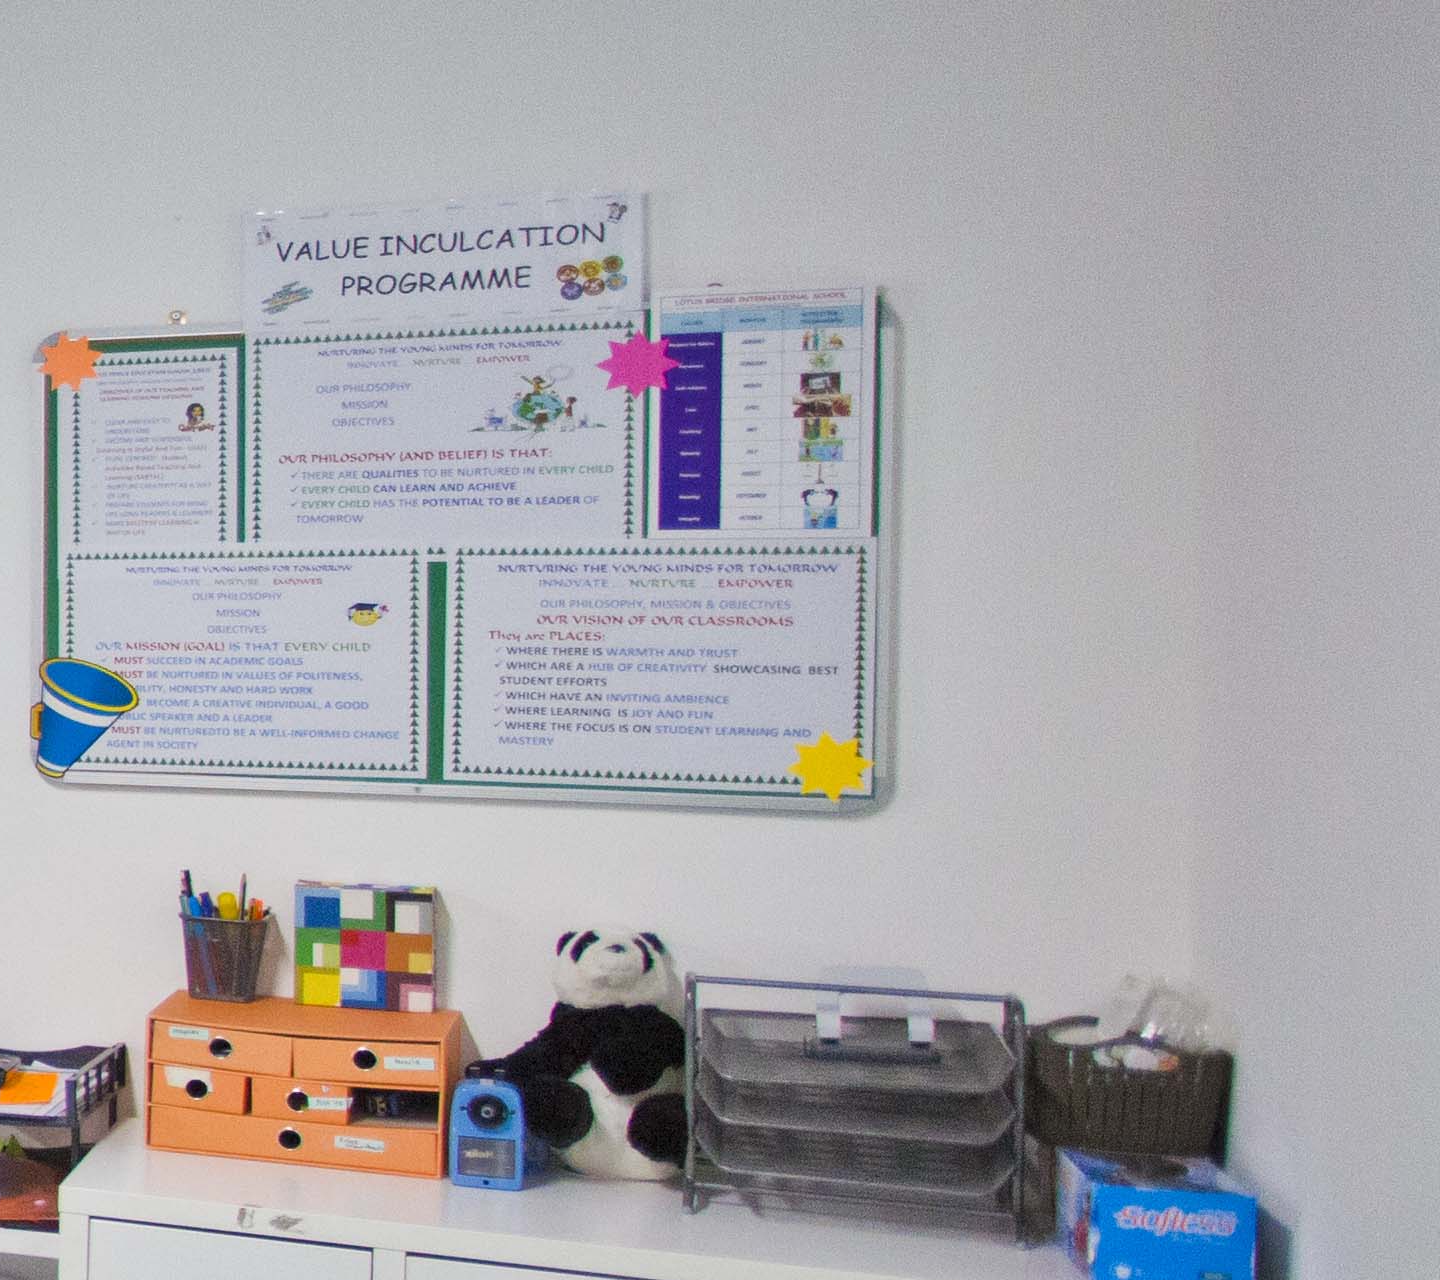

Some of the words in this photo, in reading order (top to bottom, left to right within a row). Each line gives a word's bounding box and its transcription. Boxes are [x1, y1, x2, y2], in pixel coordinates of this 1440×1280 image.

[277, 236, 368, 262] VALUE
[379, 222, 606, 257] INCULCATION
[341, 266, 532, 296] PROGRAMME
[278, 454, 307, 464] OUR
[311, 452, 396, 463] PHILOSOPHY
[492, 449, 504, 459] IS
[510, 448, 552, 458] THAT:
[301, 486, 335, 495] EVERY
[338, 485, 370, 494] CHILD
[373, 485, 396, 493] CAN
[400, 484, 436, 493] LEARN
[440, 483, 464, 492] AND
[468, 482, 517, 491] ACHIEVE
[498, 564, 578, 573] NURTURING
[583, 564, 607, 573] THE
[612, 564, 662, 573] YOUNG
[666, 564, 713, 573] MINDS
[718, 564, 744, 573] FOR
[749, 564, 838, 573] TOMORROW
[537, 615, 568, 625] OUR
[572, 615, 624, 625] VISION
[628, 615, 647, 625] OF
[651, 615, 683, 626] OUR
[688, 616, 794, 627] CLASSROOMS
[489, 630, 520, 641] They
[550, 631, 605, 641] PLACES:
[506, 647, 548, 656] WHERE
[552, 647, 589, 656] THERE
[593, 647, 603, 656] IS
[606, 648, 663, 657] WARMTH
[667, 649, 695, 657] AND
[699, 649, 738, 658] TRUST
[506, 662, 546, 670] WHICH
[550, 662, 573, 671] ARE
[575, 662, 585, 671] A
[588, 663, 614, 671] HUB
[617, 663, 633, 672] OF
[636, 663, 706, 672] CREATIVITY
[713, 665, 801, 675] SHOWCASING
[808, 666, 838, 675] BEST
[499, 676, 552, 685] STUDENT
[556, 677, 607, 686] EFFORTS
[506, 691, 546, 700] WHICH
[550, 692, 581, 701] HAVE
[585, 693, 602, 702] AN
[606, 694, 660, 703] INVITING
[664, 695, 729, 704] AMBIENCE
[505, 707, 547, 716] WHERE
[551, 707, 611, 717] LEARNING
[618, 709, 628, 718] IS
[631, 709, 653, 718] JOY
[656, 710, 684, 718] AND
[688, 711, 714, 719] FUN
[505, 721, 547, 730] WHERE
[551, 722, 572, 731] THE
[576, 723, 615, 732] FOCUS
[619, 724, 629, 733] IS
[632, 725, 651, 733] ON
[655, 726, 711, 735] STUDENT
[715, 727, 779, 737] LEARNING
[783, 728, 812, 737] AND
[498, 736, 554, 745] MASTERY
